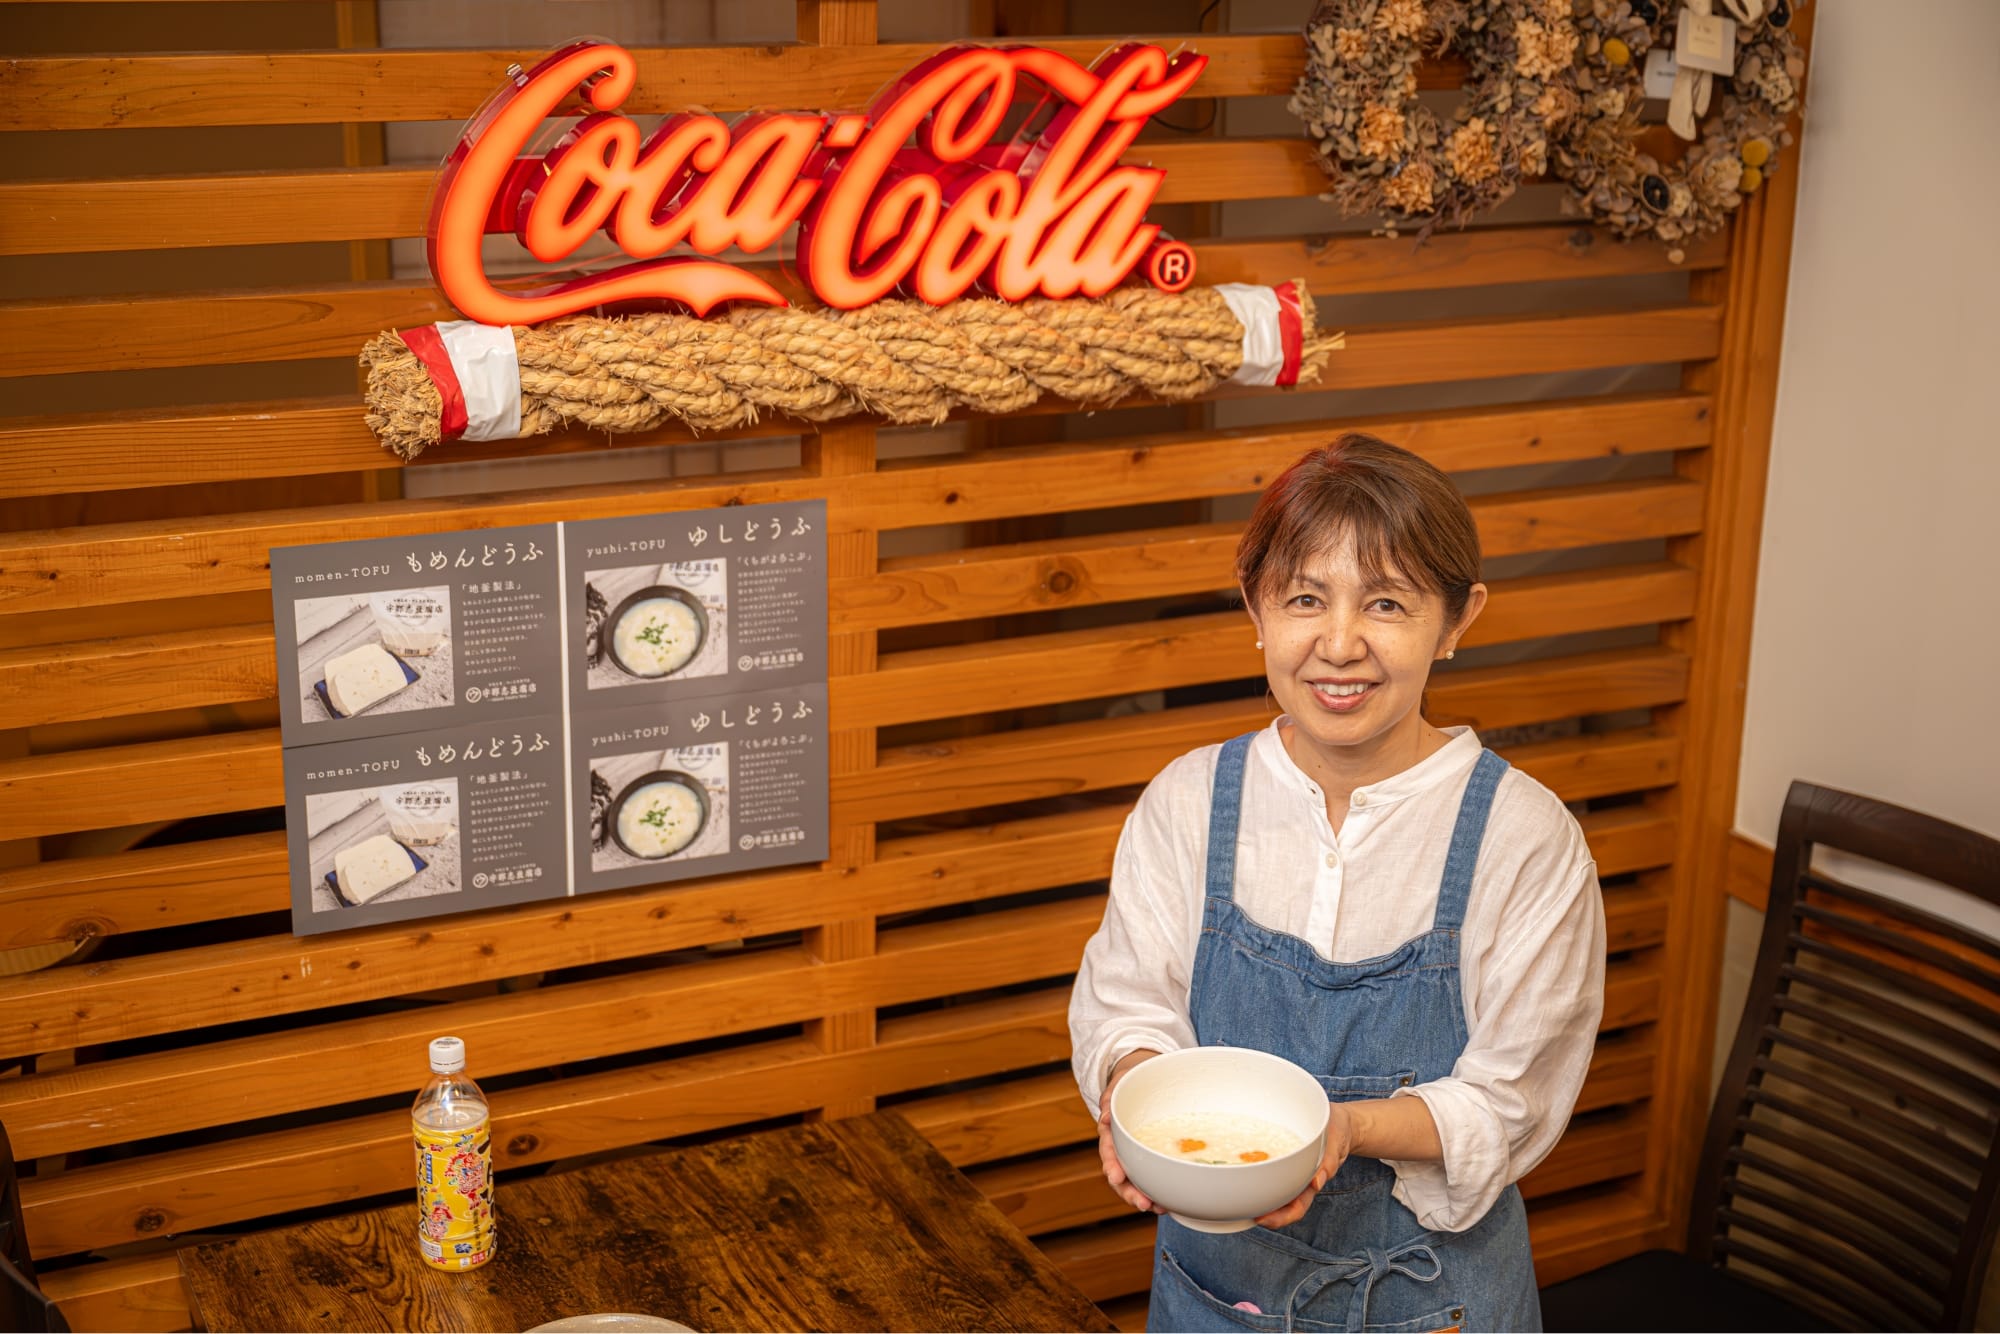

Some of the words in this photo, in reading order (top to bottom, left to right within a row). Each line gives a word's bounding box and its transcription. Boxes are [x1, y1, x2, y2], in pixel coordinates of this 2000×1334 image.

[429, 41, 1209, 324] Coca-Cola
[688, 517, 811, 548] ゆしどうふ
[406, 541, 544, 573] もめんどうふ
[586, 539, 666, 558] yushi-TOFU
[295, 564, 391, 583] momen-TOFU
[691, 701, 813, 733] ゆしどうふ
[416, 733, 550, 766] もめんどうふ
[592, 726, 670, 747] yushi-TOFU
[306, 759, 400, 780] momen-TOFU
